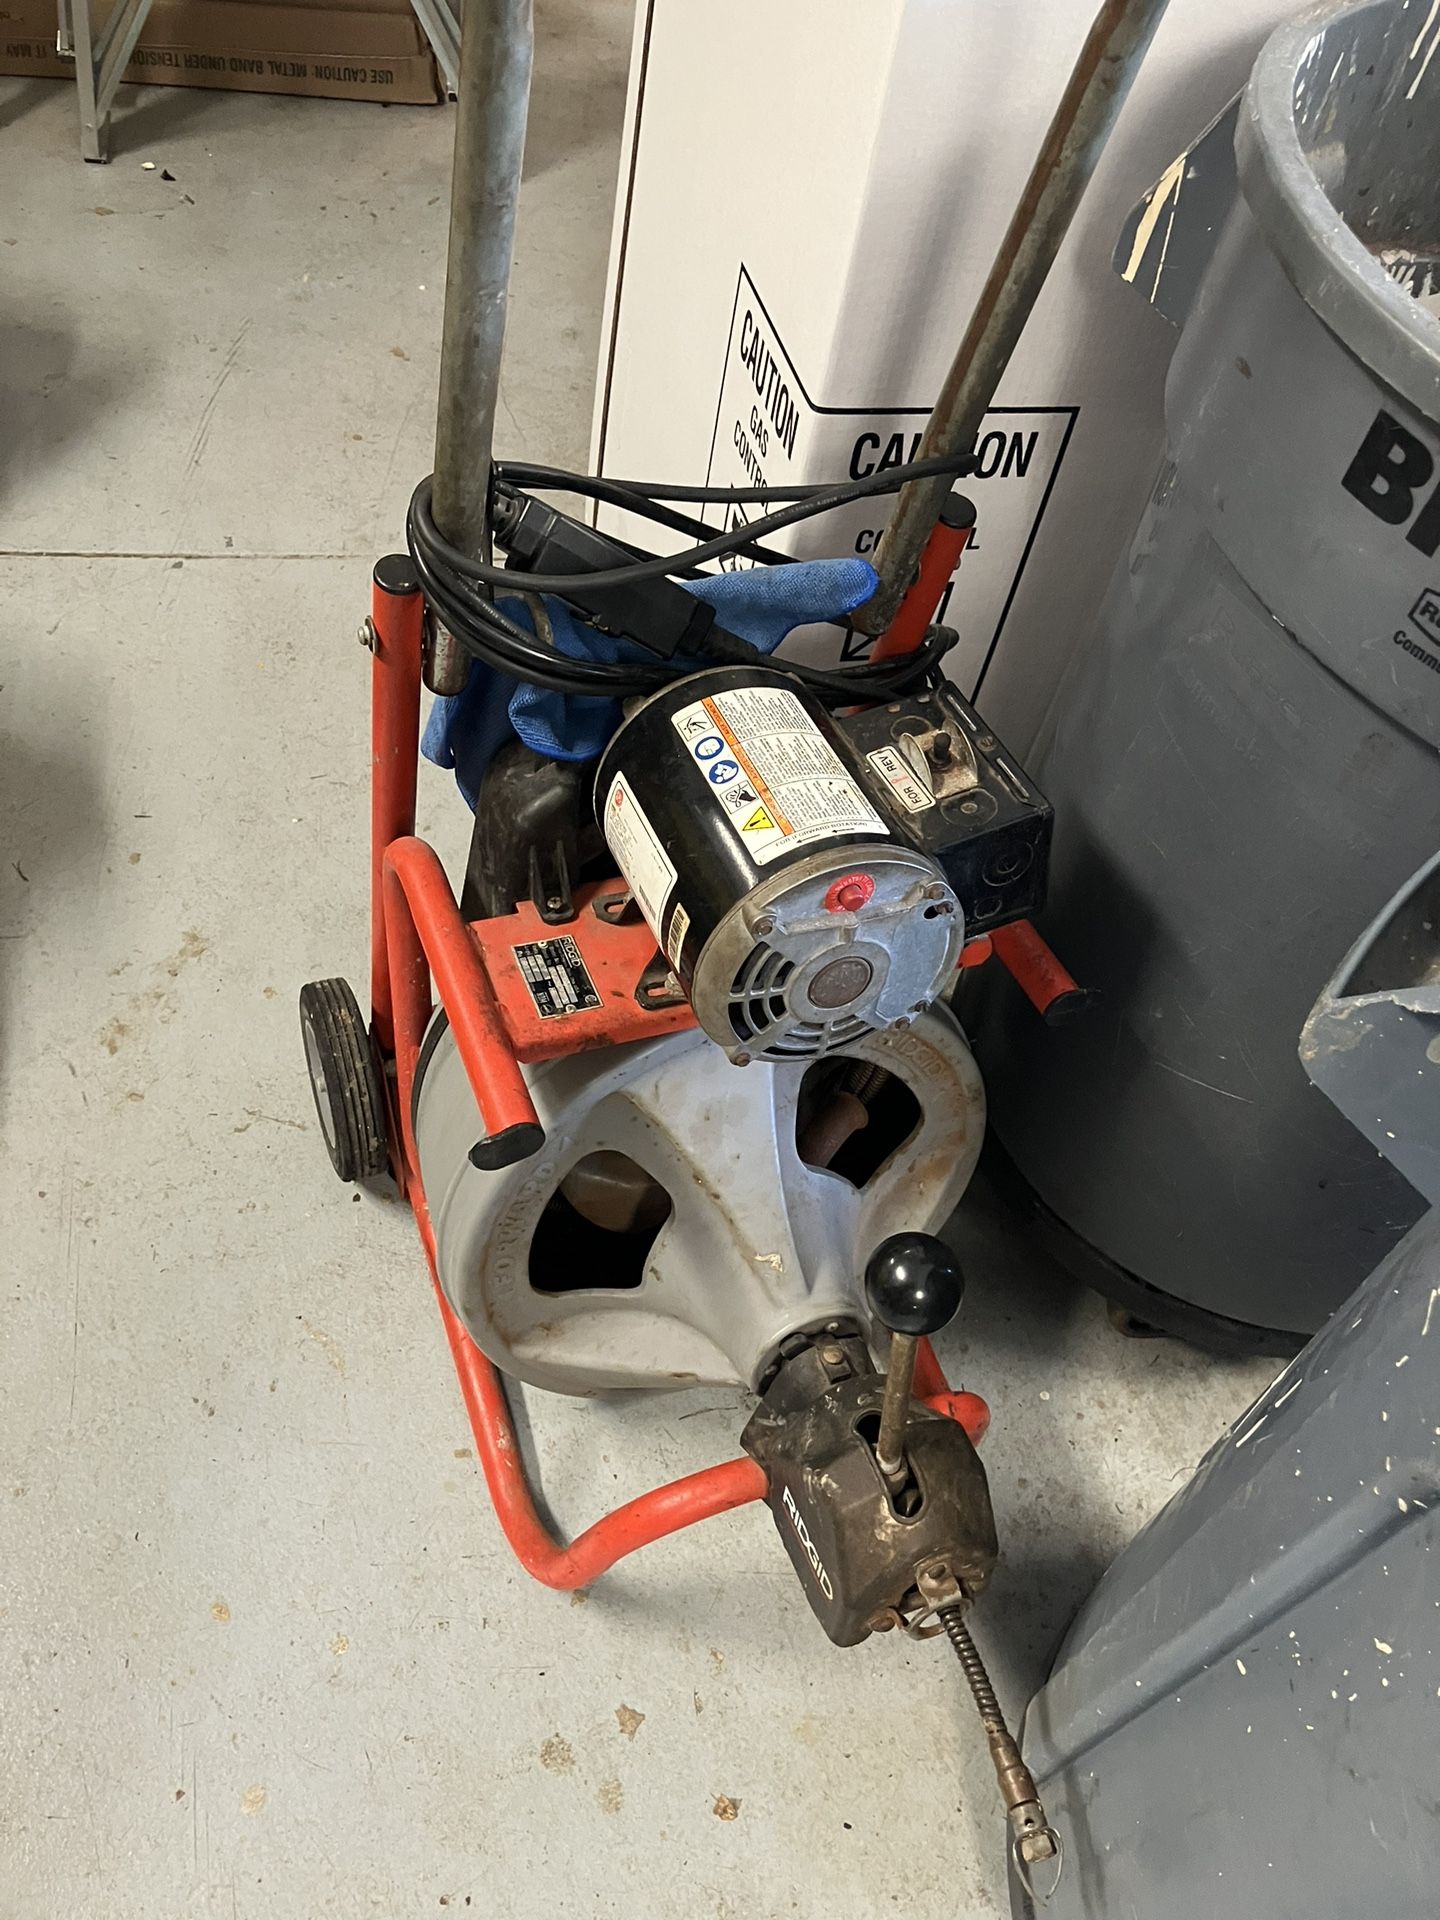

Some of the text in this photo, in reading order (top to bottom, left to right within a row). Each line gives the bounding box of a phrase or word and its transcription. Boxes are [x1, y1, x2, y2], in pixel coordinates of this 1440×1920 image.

[184, 52, 225, 71] UNDER
[230, 57, 264, 75] BAND
[267, 60, 307, 77] METAL
[370, 69, 393, 85] USE
[740, 309, 800, 461] CAUTION
[750, 404, 769, 458] GAS
[878, 755, 897, 773] REV
[903, 785, 922, 804] FOR
[782, 1485, 834, 1601] RIDGID
